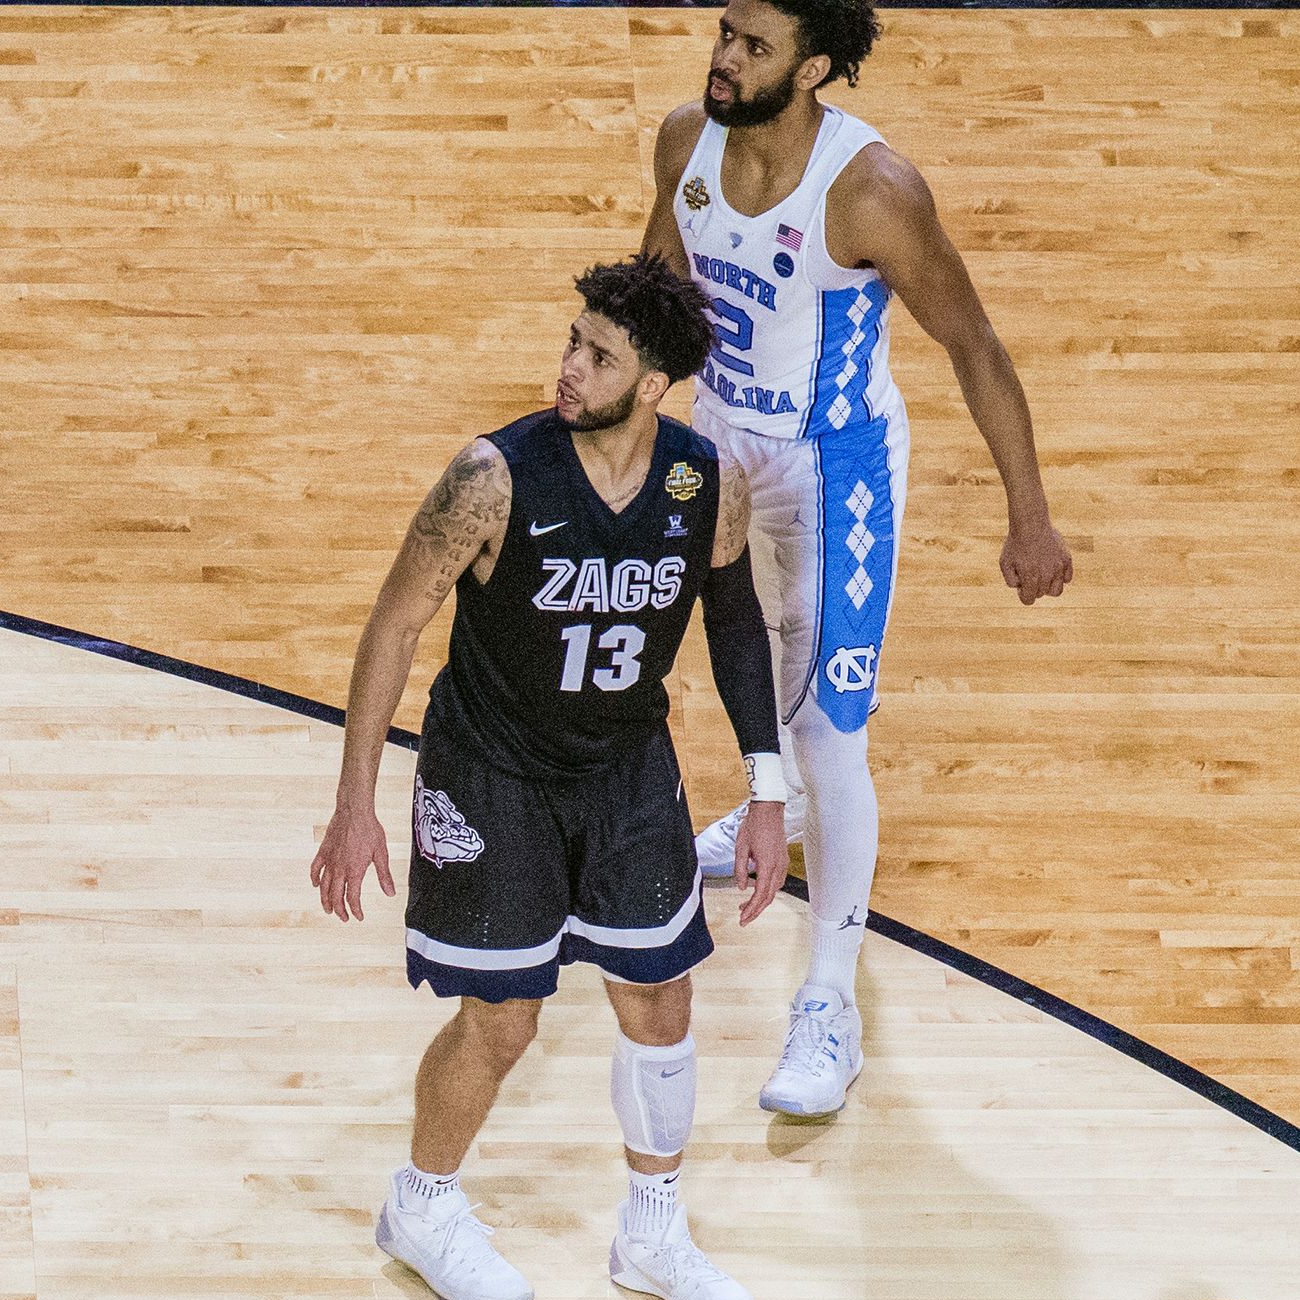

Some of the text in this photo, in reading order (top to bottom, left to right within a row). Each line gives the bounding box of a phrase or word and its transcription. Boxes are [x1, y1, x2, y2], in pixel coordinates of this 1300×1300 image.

[693, 253, 777, 312] NORTH
[531, 556, 687, 612] ZAGS
[560, 624, 646, 692] 13
